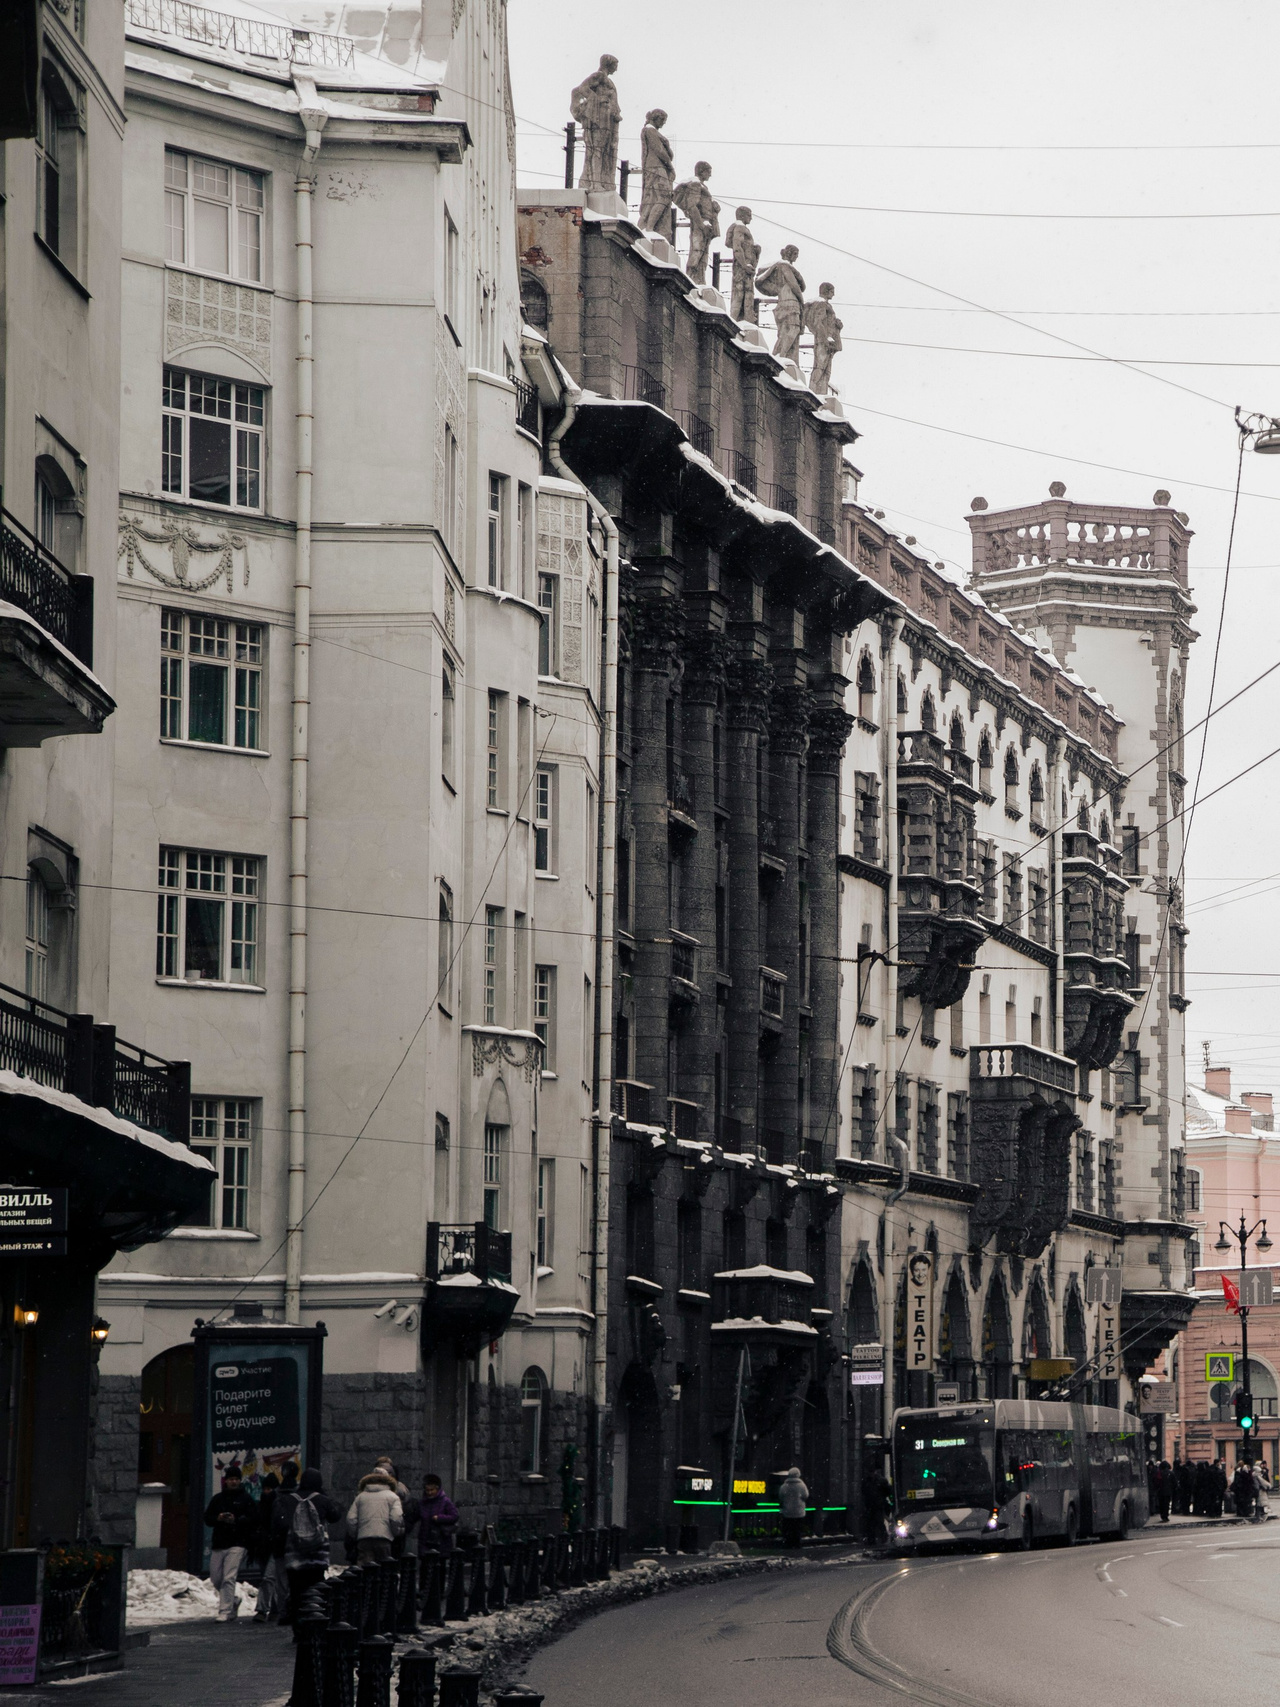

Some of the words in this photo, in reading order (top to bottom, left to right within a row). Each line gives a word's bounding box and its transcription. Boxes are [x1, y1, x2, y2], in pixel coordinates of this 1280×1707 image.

[0, 1194, 53, 1207] ВИЛЛЬ
[26, 1217, 52, 1226] ВЕЩЕЙ
[22, 1242, 44, 1250] ЭТАЖ
[913, 1295, 926, 1366] ТЕАТР
[1104, 1318, 1115, 1376] ТЕАТР
[240, 1367, 272, 1375] Участие
[215, 1389, 272, 1401] Подарите
[215, 1403, 249, 1415] билет
[215, 1419, 223, 1429] в
[225, 1415, 276, 1429] будущее
[915, 1439, 924, 1450] 31
